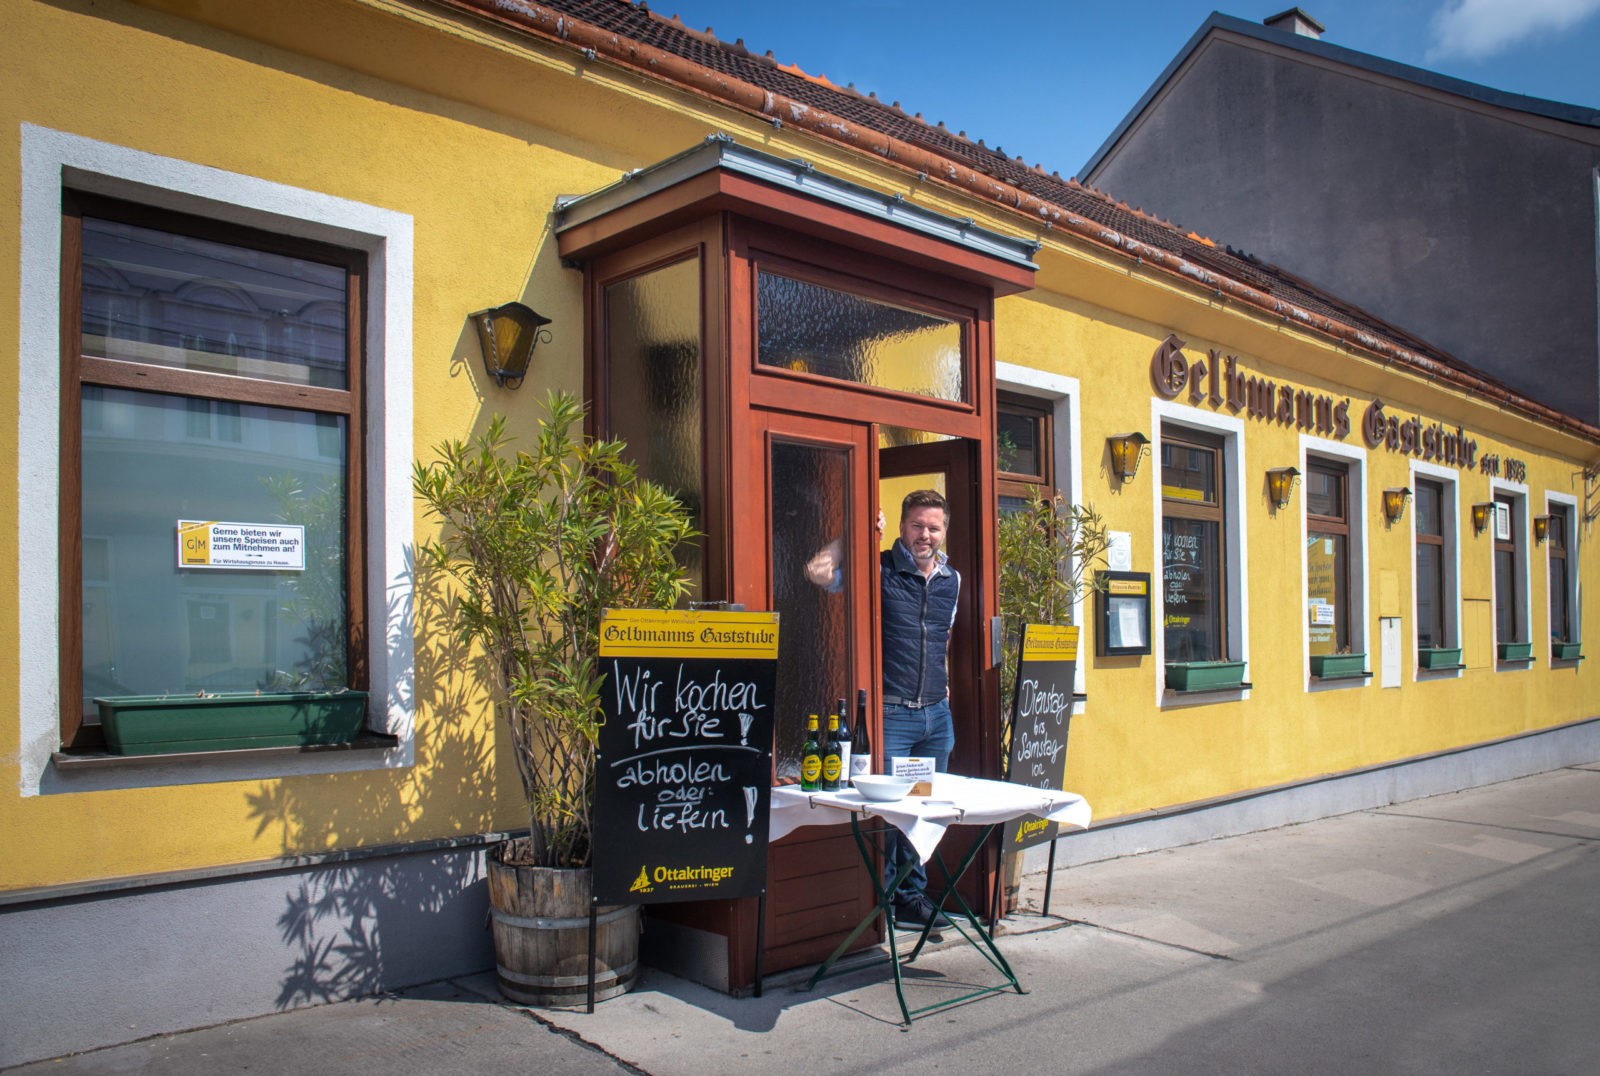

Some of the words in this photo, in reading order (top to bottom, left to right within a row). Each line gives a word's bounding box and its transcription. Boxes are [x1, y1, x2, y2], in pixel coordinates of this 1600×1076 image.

[1149, 334, 1350, 440] Gelbmanns
[1362, 398, 1477, 470] Gaststube
[213, 527, 238, 535] Gerne
[213, 535, 242, 543] unsere
[244, 537, 277, 545] Speisen
[233, 543, 280, 552] Mitnehmen
[282, 544, 295, 552] an!
[604, 625, 695, 643] Gelbmanns
[700, 627, 775, 644] Gaststube
[614, 659, 664, 716] Wir
[675, 662, 767, 713] kochen
[1020, 679, 1068, 725] Dienstag
[669, 711, 725, 738] Sie
[1033, 717, 1046, 736] bis
[1017, 732, 1064, 765] Samstag
[616, 756, 731, 788] abholen
[637, 803, 729, 834] liefern
[653, 866, 734, 883] Ottakringer
